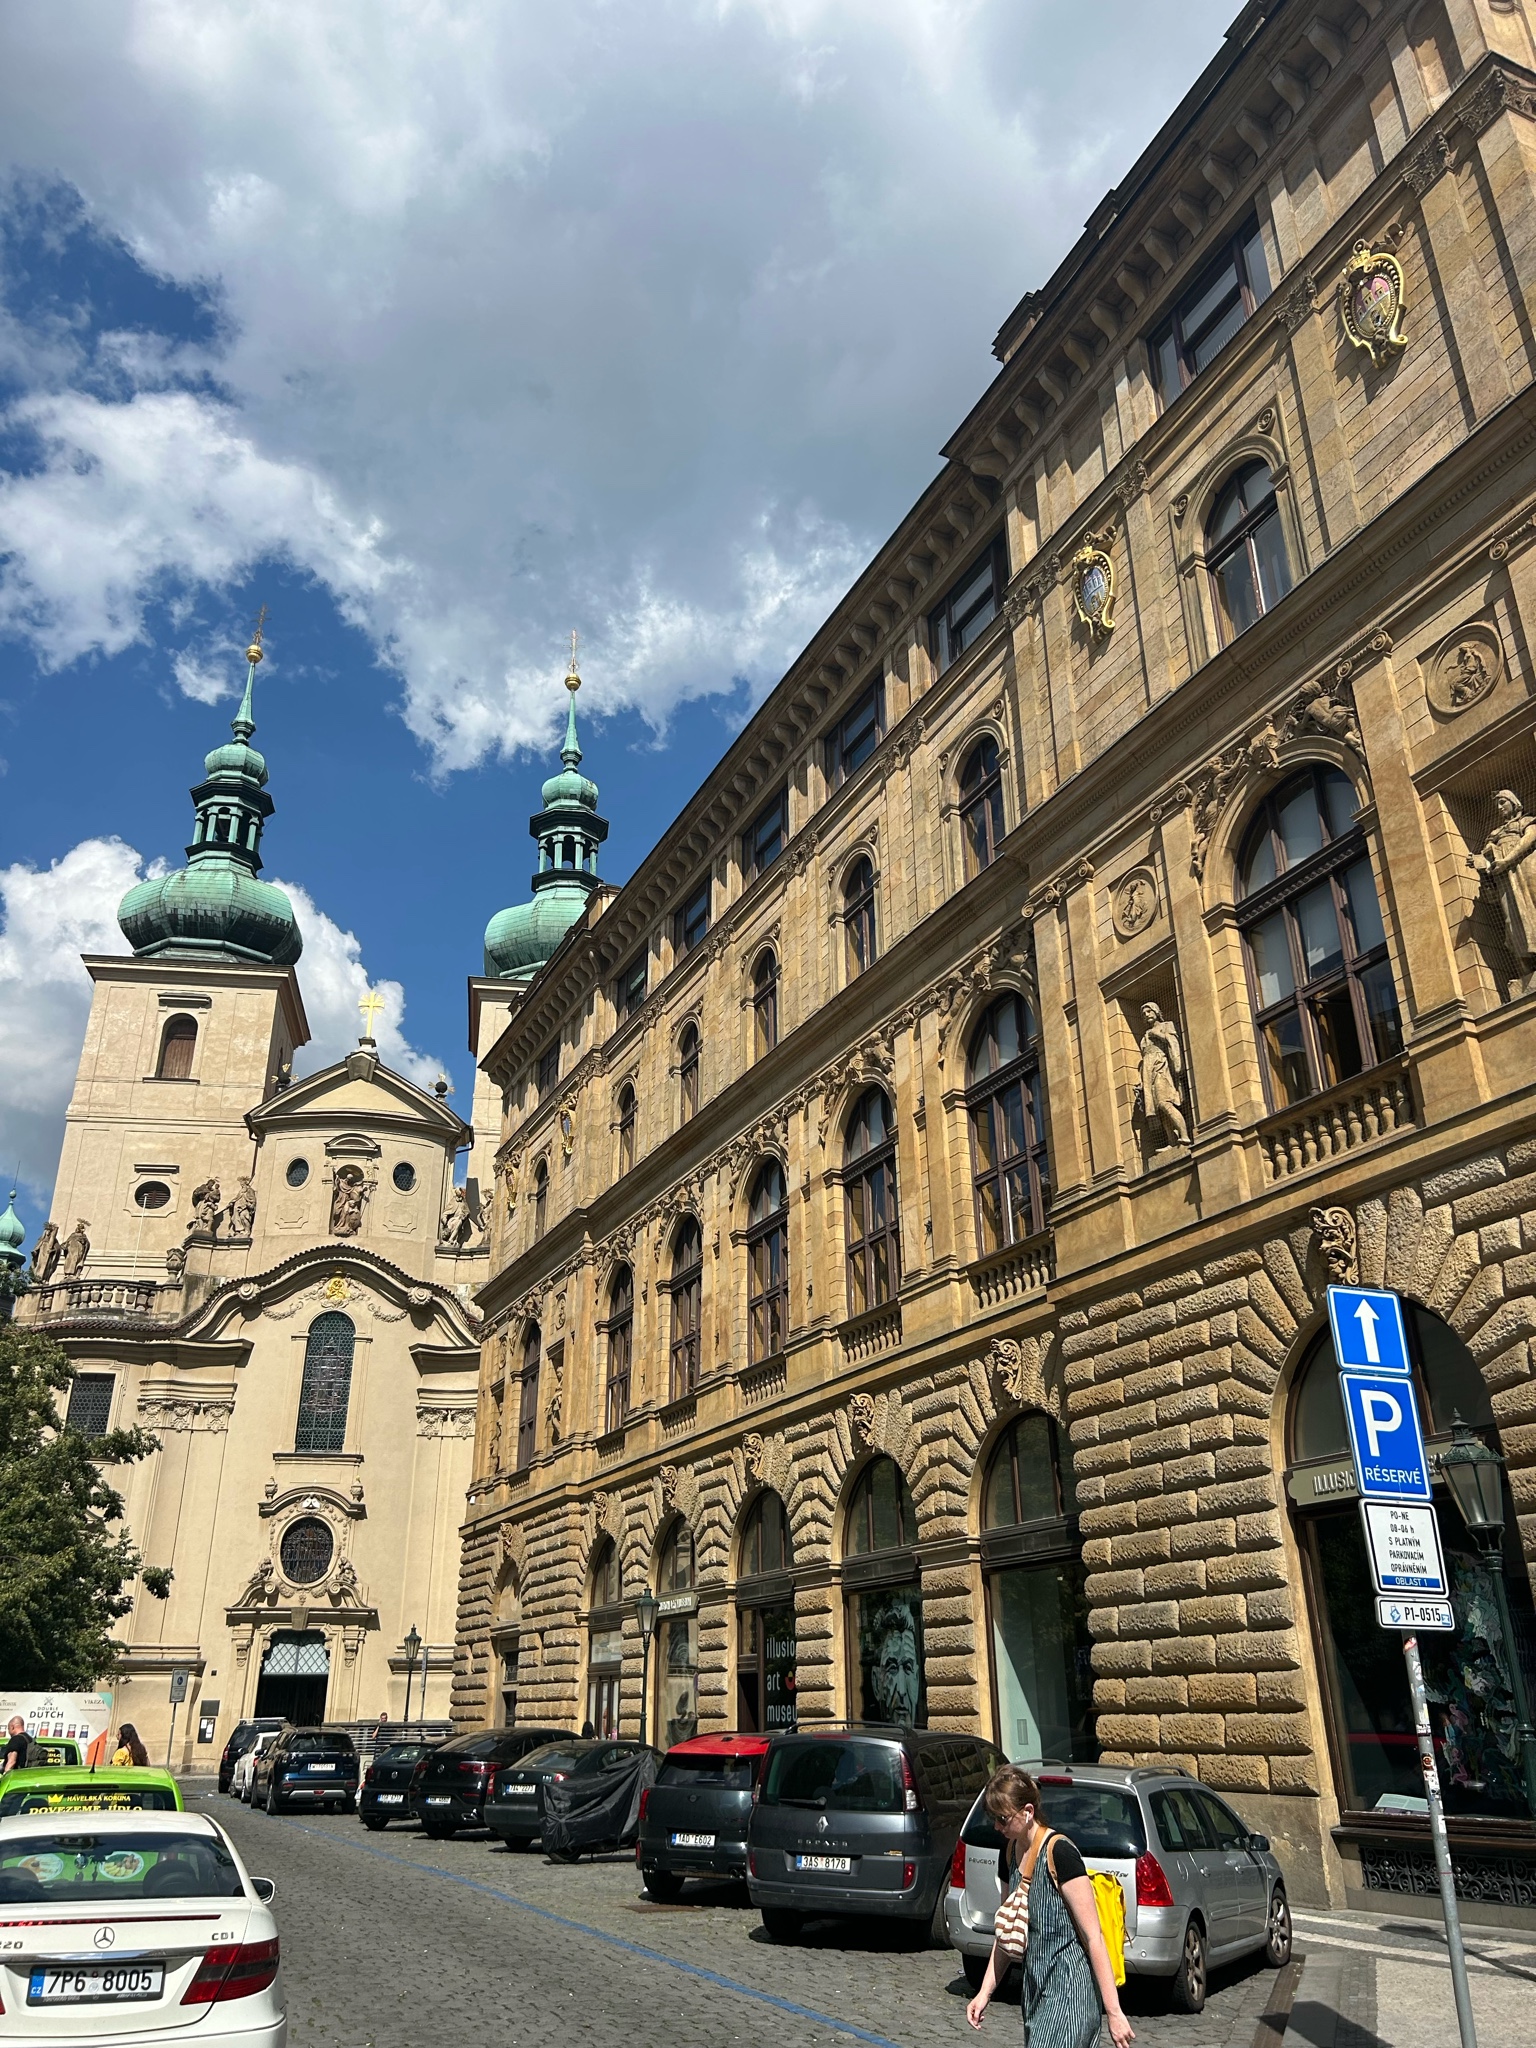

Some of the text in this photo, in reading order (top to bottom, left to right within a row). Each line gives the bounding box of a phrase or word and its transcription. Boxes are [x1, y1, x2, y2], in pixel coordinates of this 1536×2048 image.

[1360, 1389, 1403, 1457] P
[1364, 1464, 1423, 1485] RÉSERVÉ
[1390, 1510, 1410, 1520] PO-NE
[1388, 1536, 1421, 1547] S PLATNÝM
[1389, 1549, 1425, 1561] PARKOVACÍM
[1390, 1561, 1427, 1574] OPRÁVNĚNÍM
[1395, 1577, 1421, 1586] OBLAST
[1404, 1606, 1441, 1622] P1-0515
[766, 1671, 781, 1691] art
[29, 1711, 64, 1719] DUTCH
[825, 1857, 846, 1869] 8178
[968, 1857, 996, 1866] PEUGEOT
[211, 1932, 235, 1941] CDI
[31, 1969, 154, 1994] CZ 7P6 8005
